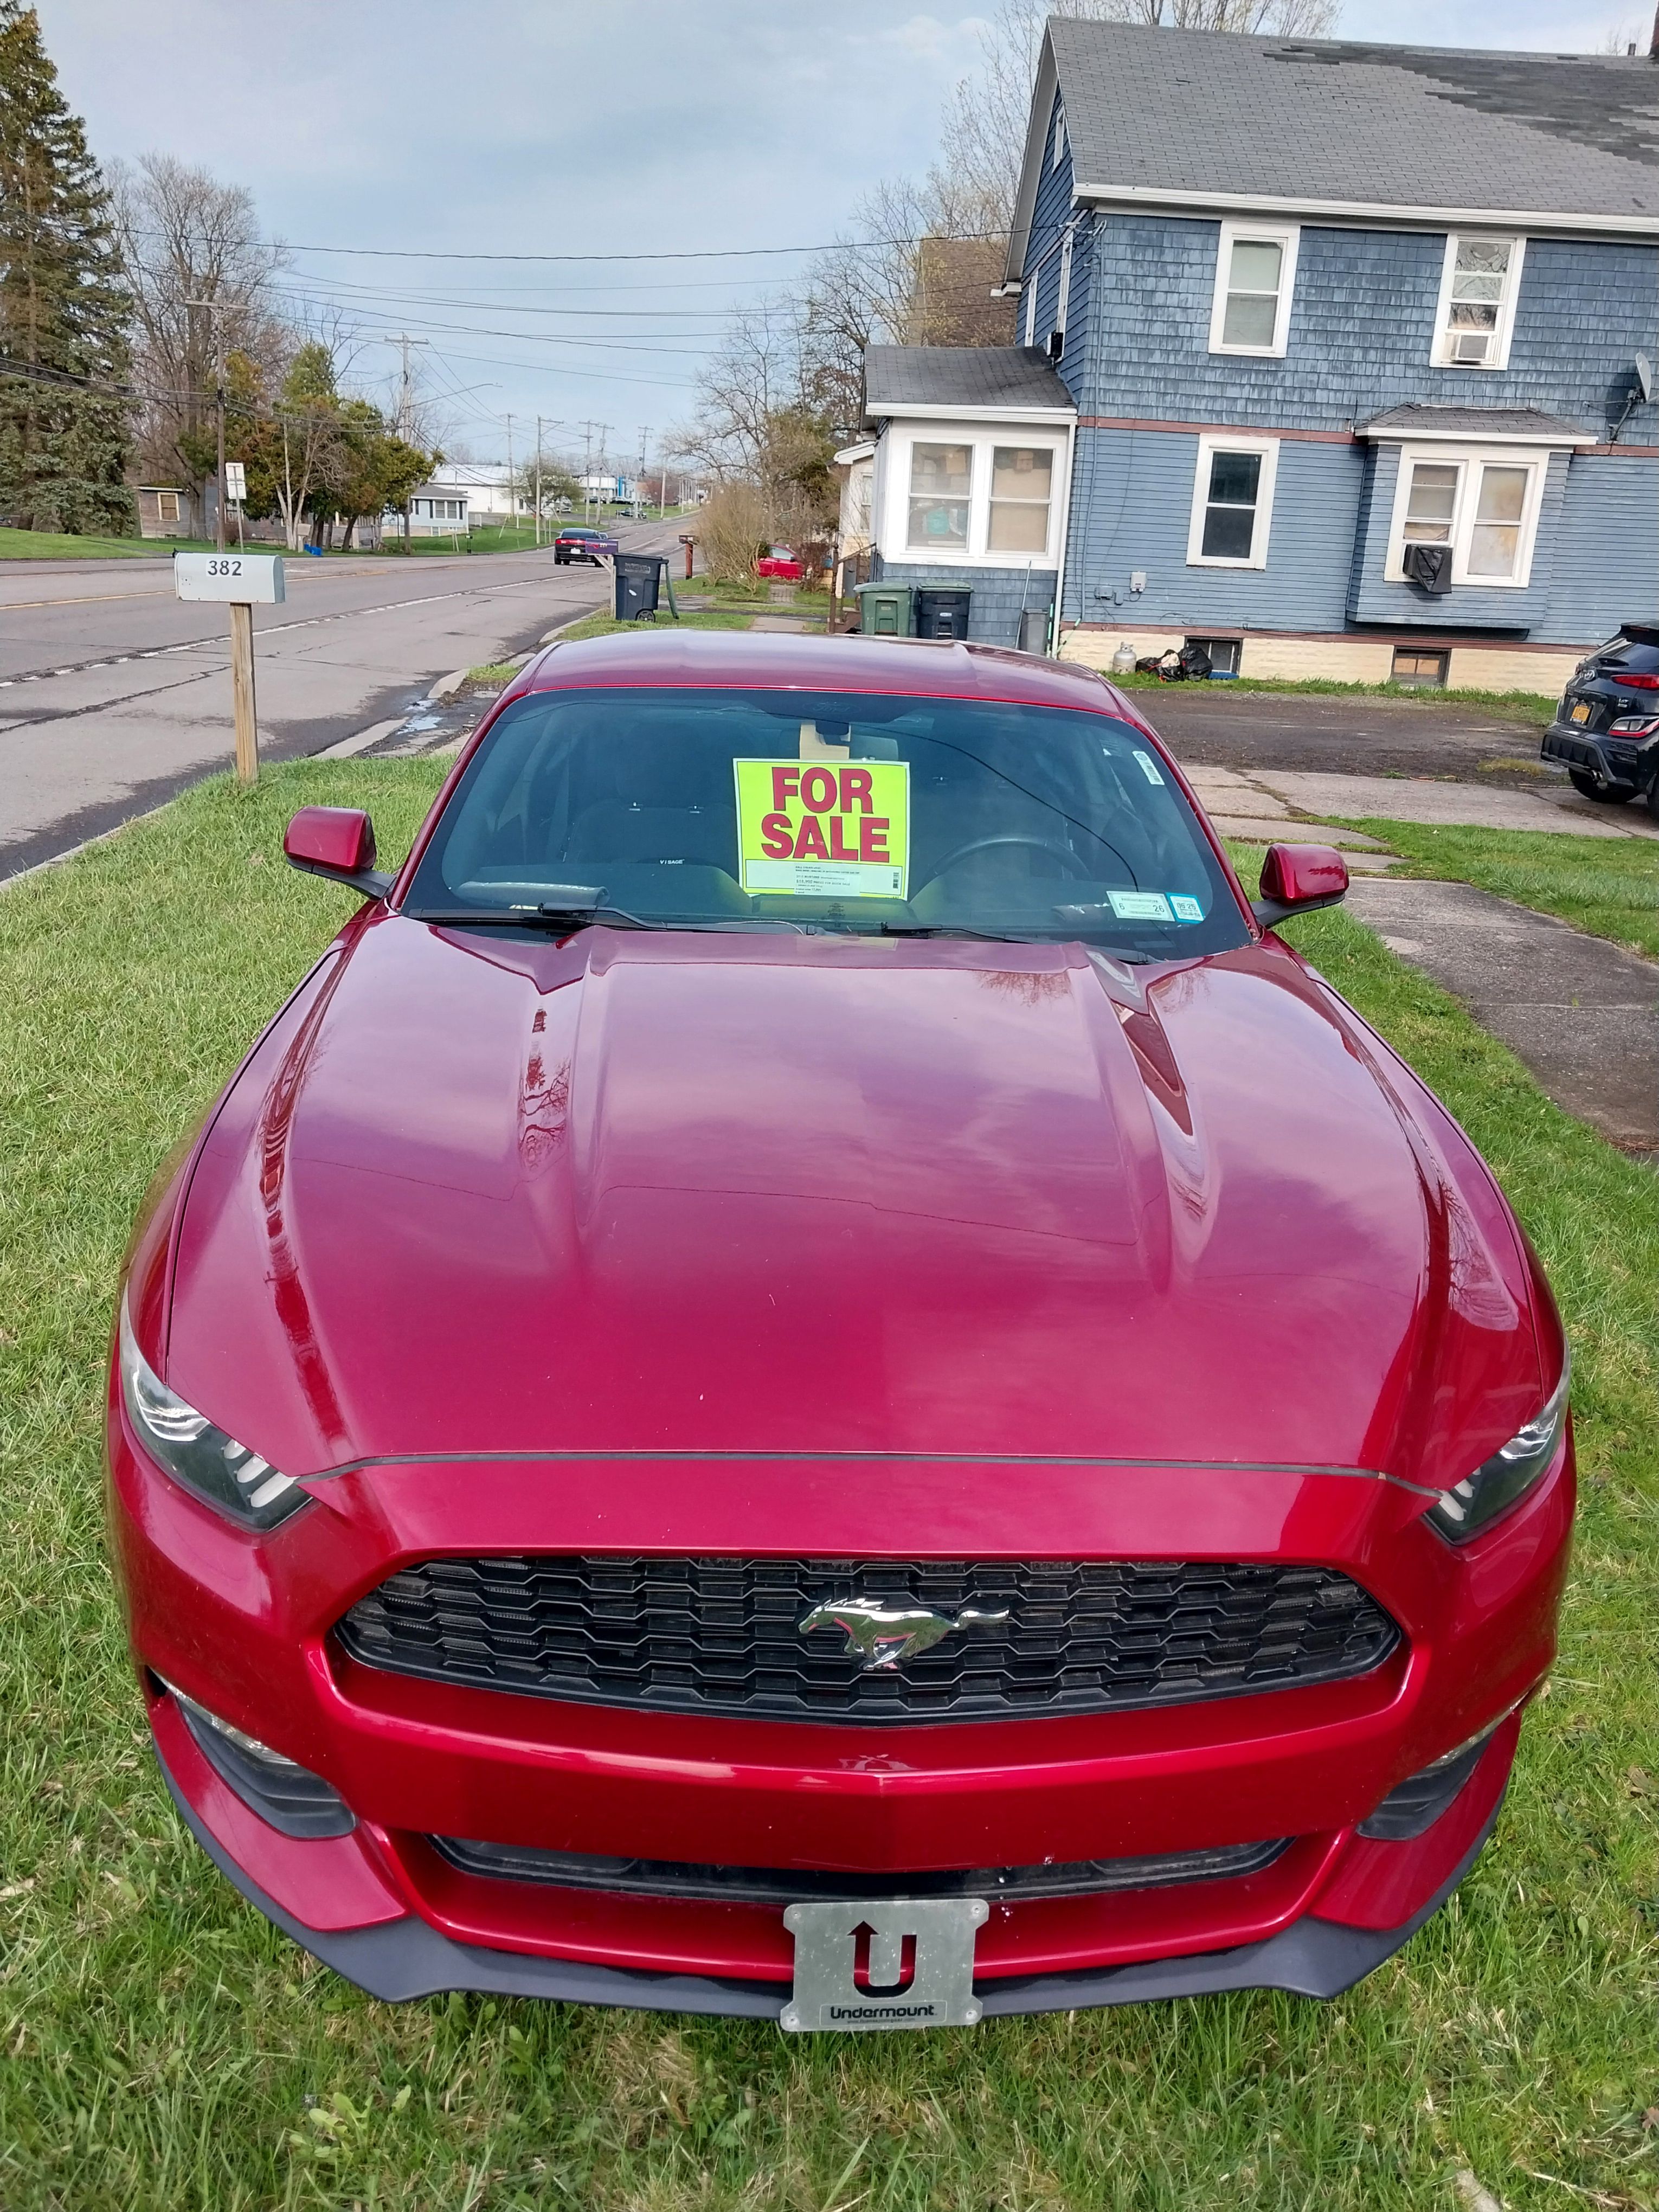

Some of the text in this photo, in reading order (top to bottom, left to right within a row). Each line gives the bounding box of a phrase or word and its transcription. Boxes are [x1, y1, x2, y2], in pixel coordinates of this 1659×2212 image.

[208, 560, 242, 576] 382
[771, 767, 874, 814] FOR
[761, 813, 890, 863] SALE
[829, 2004, 935, 2019] Undermount
